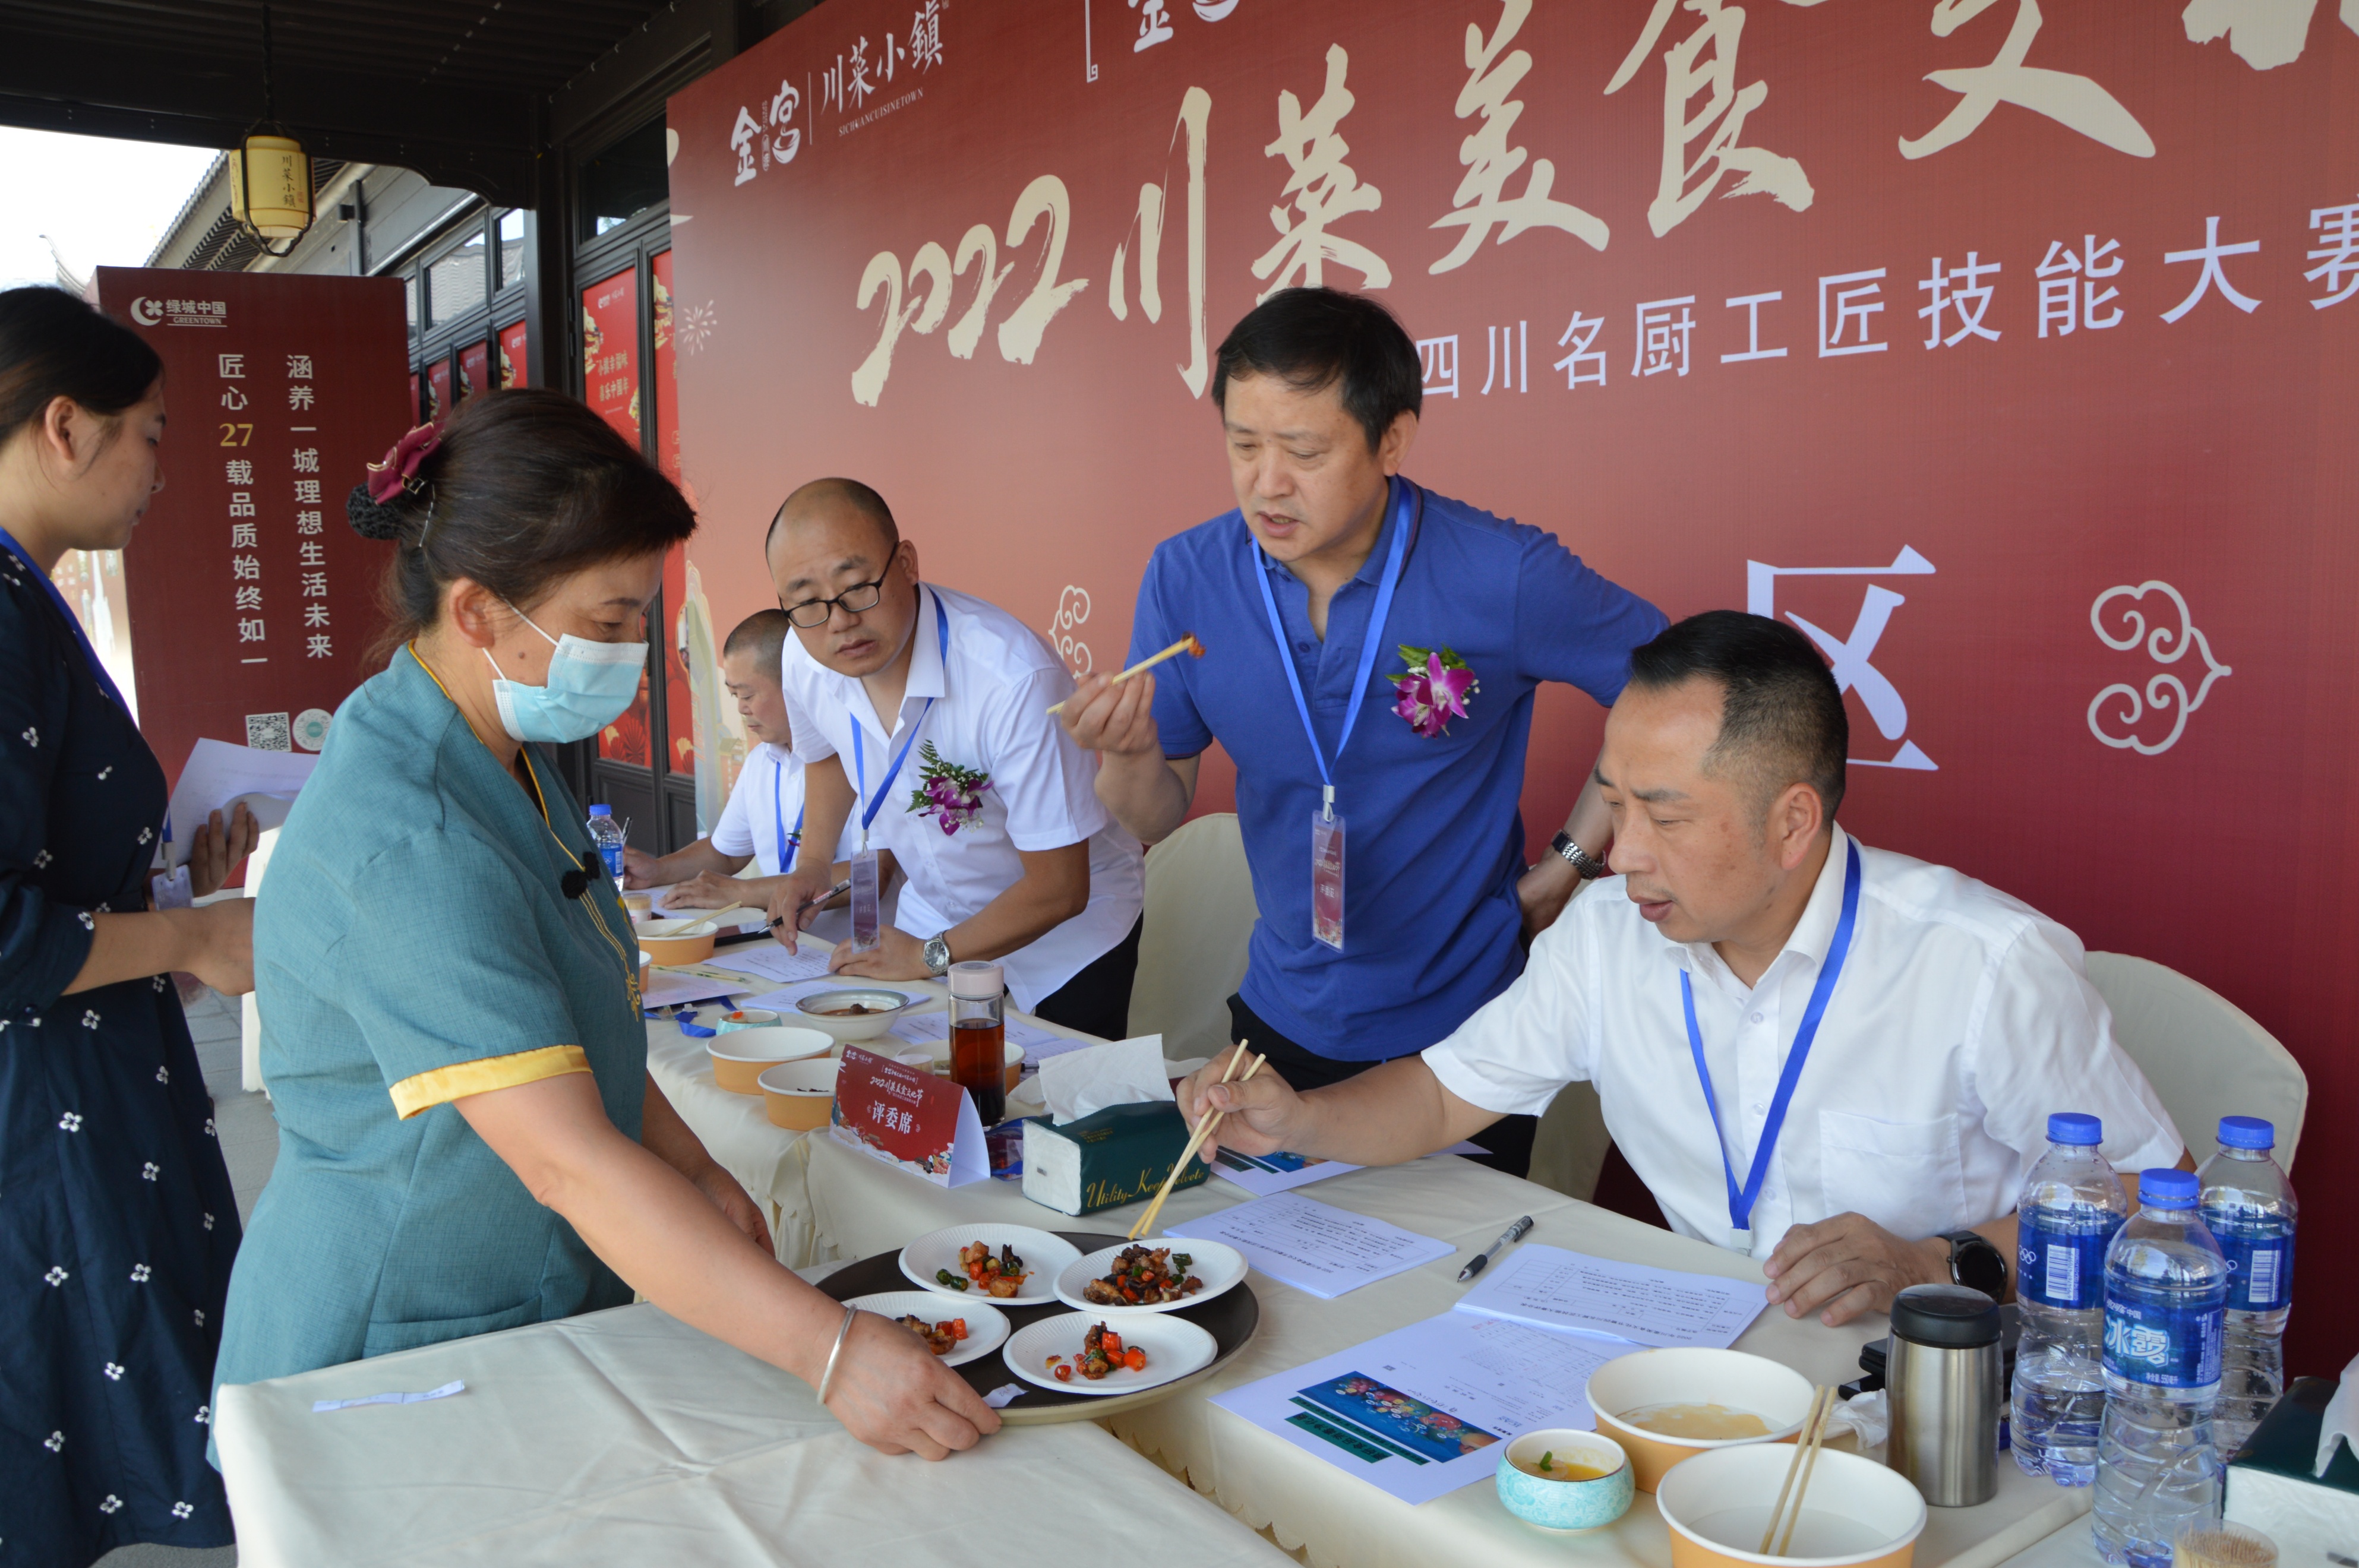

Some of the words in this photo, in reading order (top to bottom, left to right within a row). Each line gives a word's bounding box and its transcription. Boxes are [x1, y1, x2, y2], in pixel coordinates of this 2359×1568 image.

[166, 299, 226, 315] 绿城中国
[173, 317, 222, 325] GREENTOWN
[286, 355, 333, 659] 涵养一城理想生活未来
[1747, 544, 1939, 770] 区
[870, 1101, 913, 1134] 评委席
[2104, 1314, 2170, 1368] 冰露
